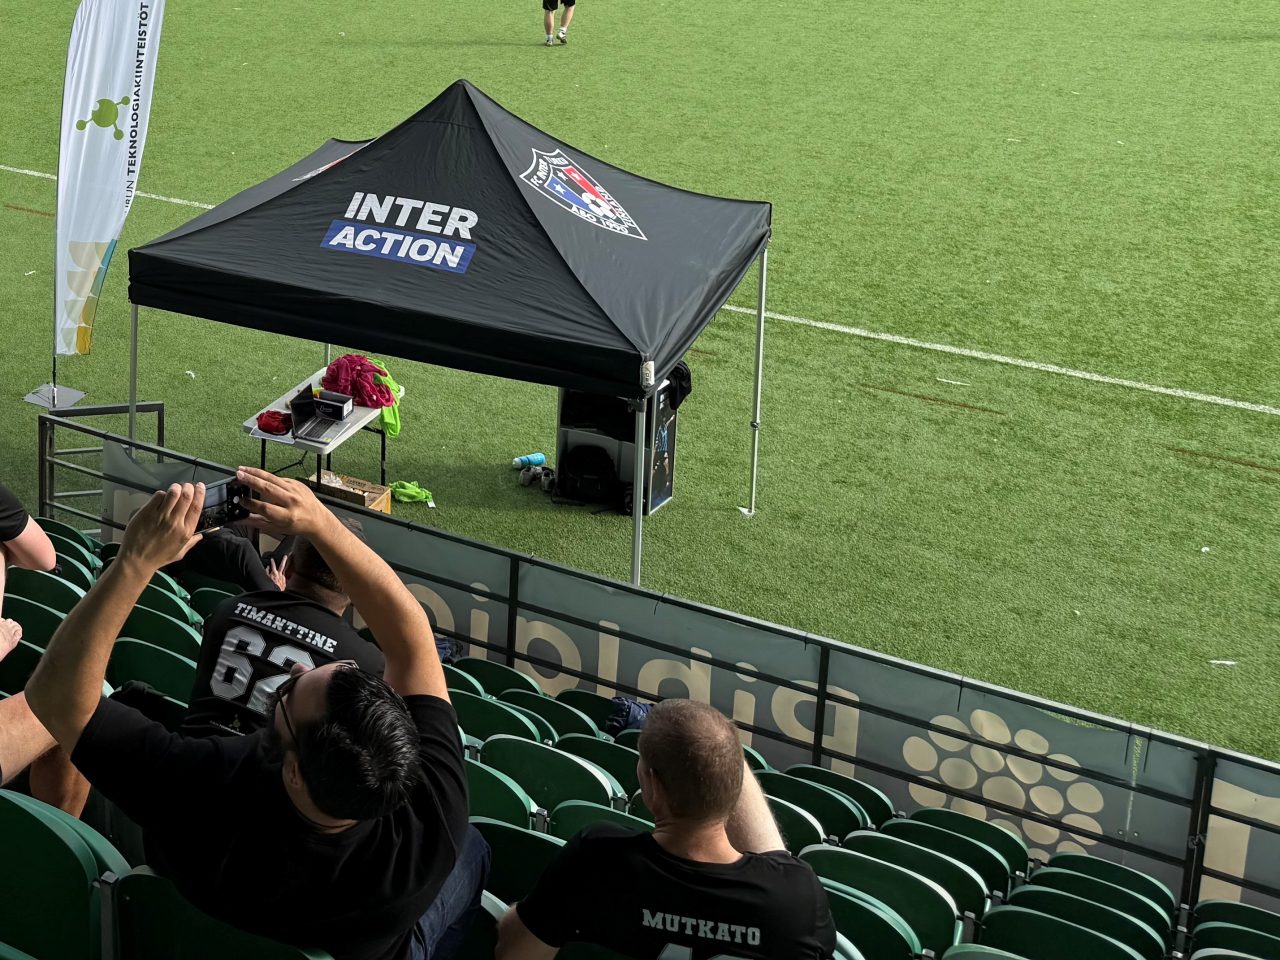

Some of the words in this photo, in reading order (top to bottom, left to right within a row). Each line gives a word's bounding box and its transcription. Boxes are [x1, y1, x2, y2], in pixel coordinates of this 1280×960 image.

[126, 1, 149, 176] TEKNOLOGIAKIINTEISTÖT
[344, 191, 480, 240] INTER
[329, 224, 465, 268] ACTION
[234, 602, 338, 653] TIMANTTINE
[642, 908, 761, 946] MUTKATO
